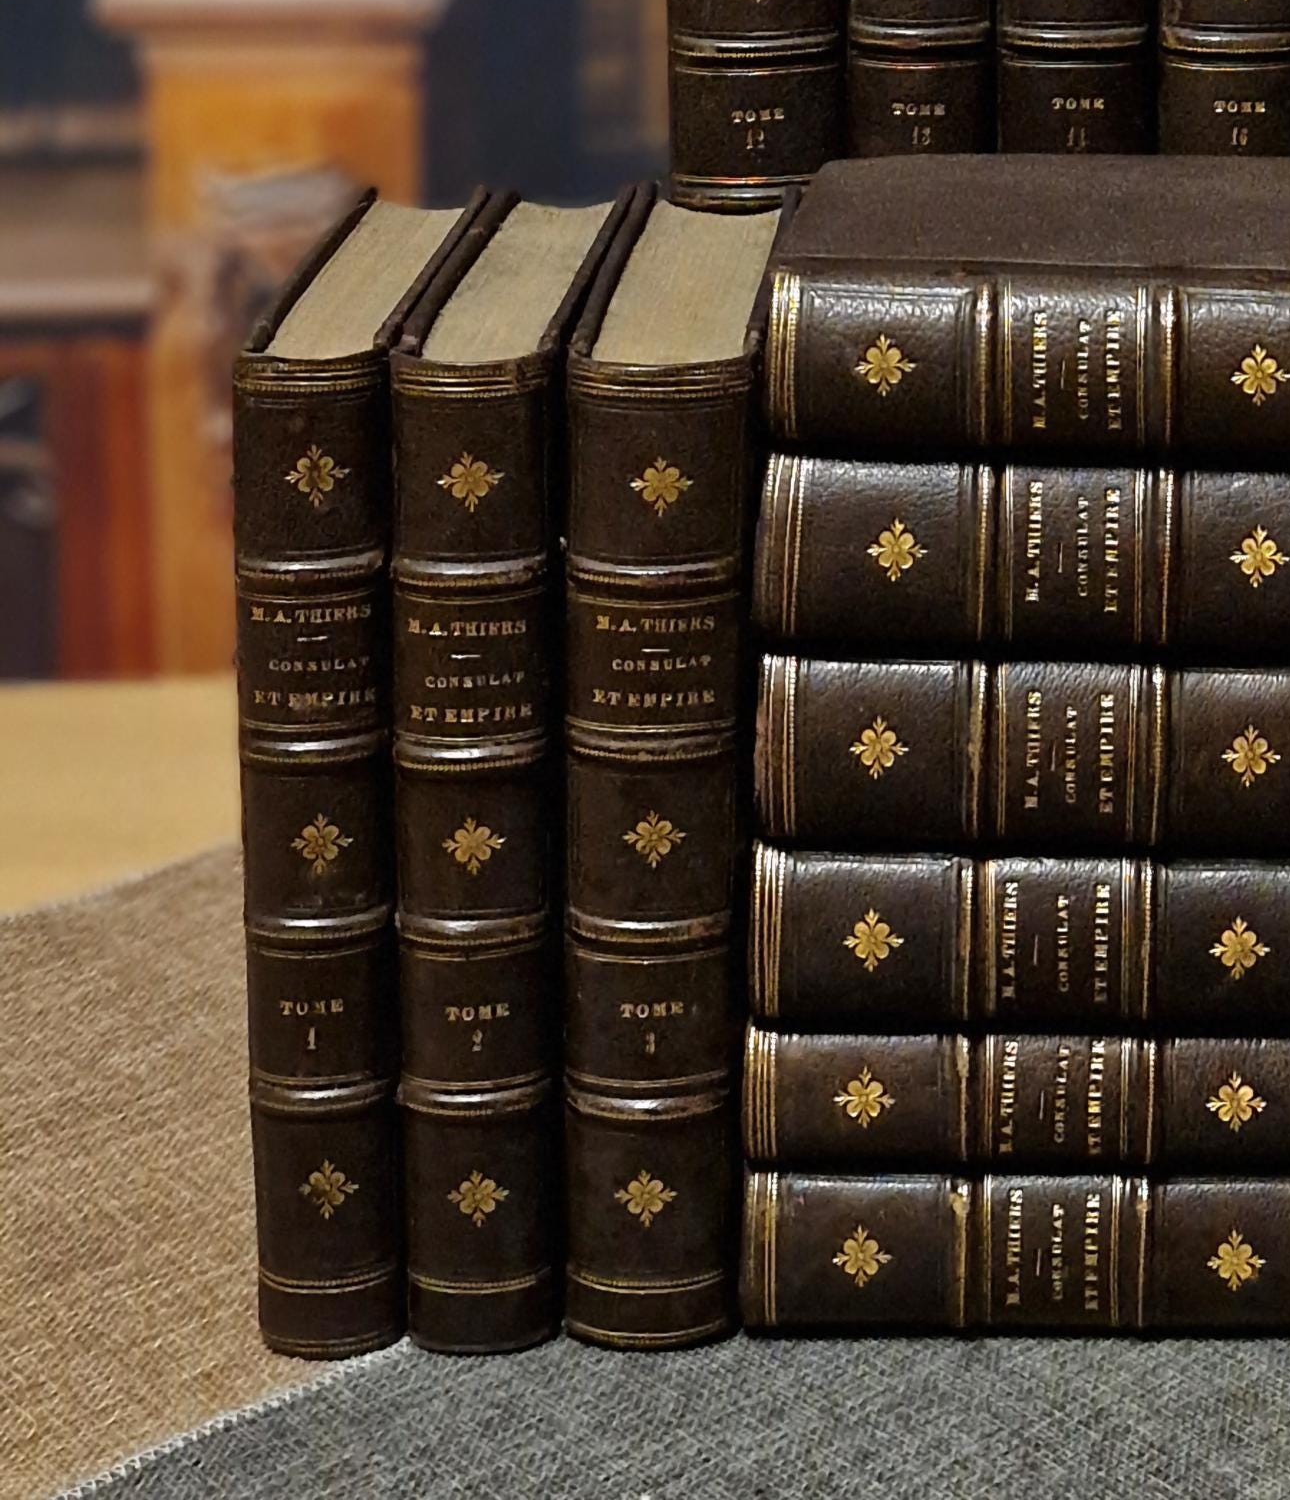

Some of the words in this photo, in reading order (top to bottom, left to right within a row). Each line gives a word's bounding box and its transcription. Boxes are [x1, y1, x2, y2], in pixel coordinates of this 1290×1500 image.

[891, 102, 946, 116] TOME
[1051, 97, 1104, 110] TOME
[1213, 100, 1265, 113] TOME
[731, 108, 785, 123] TOME
[280, 999, 345, 1016] TOME
[445, 1003, 510, 1021] TOME
[620, 1001, 684, 1019] TOME
[306, 1026, 317, 1050] 1
